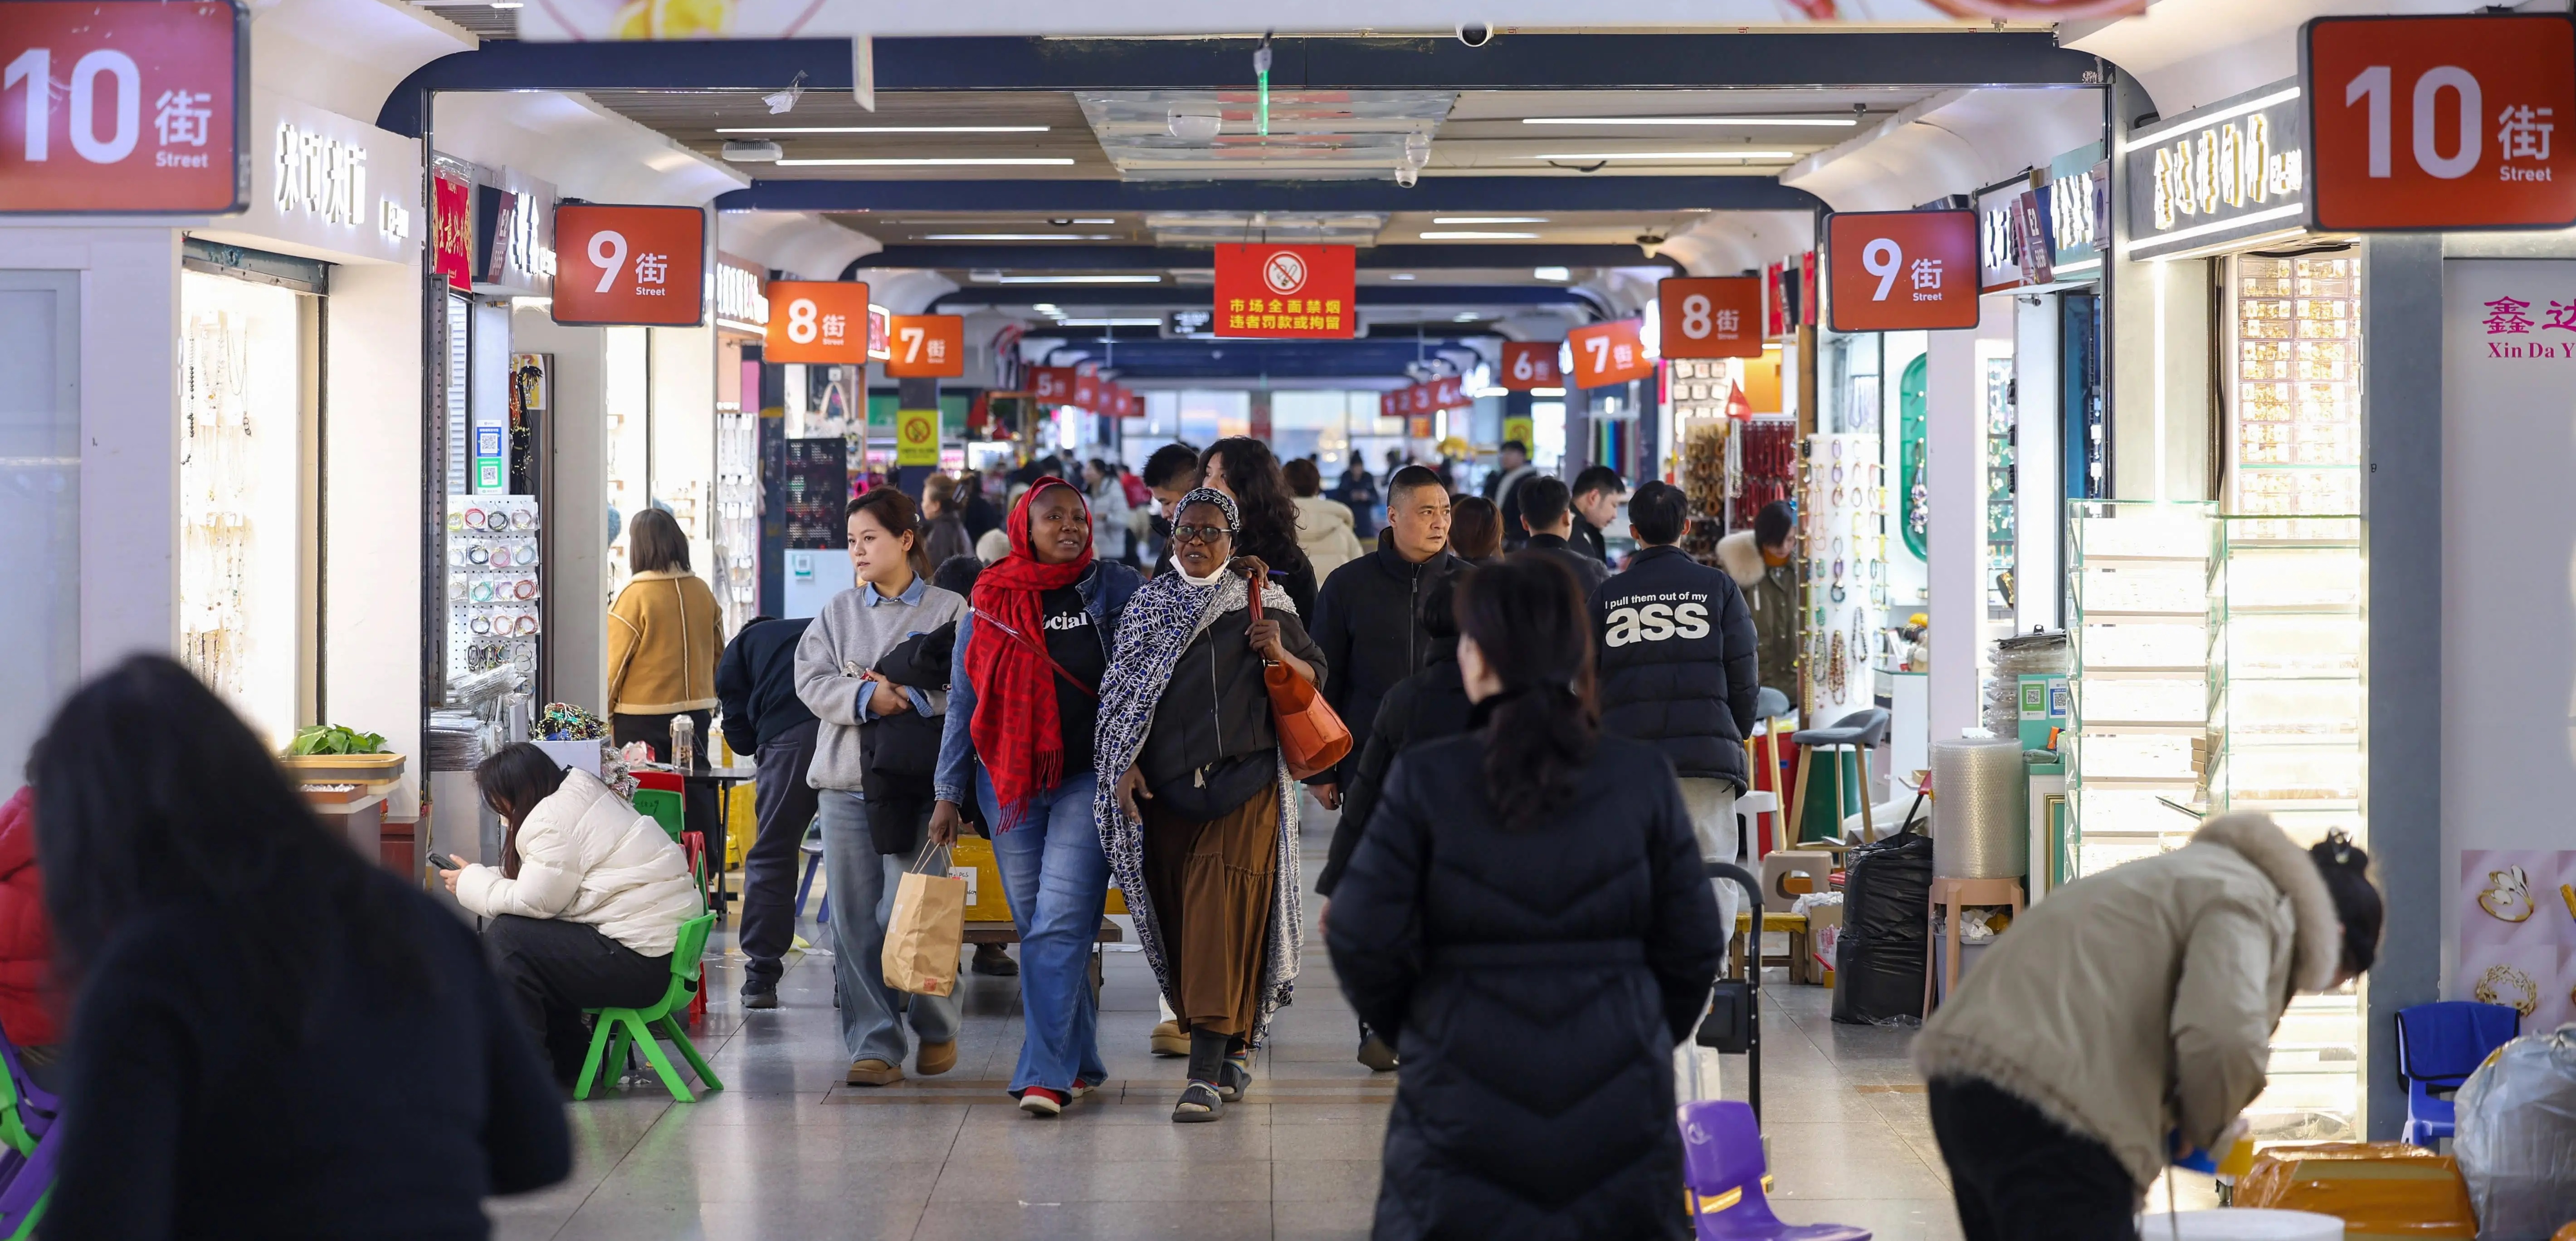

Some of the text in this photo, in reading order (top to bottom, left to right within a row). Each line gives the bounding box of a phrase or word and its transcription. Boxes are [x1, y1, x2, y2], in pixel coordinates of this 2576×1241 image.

[4, 48, 212, 164] 10 街
[2346, 66, 2482, 179] 10
[2498, 104, 2554, 161] 街
[156, 151, 208, 168] Street
[2500, 166, 2552, 182] Street
[499, 209, 509, 237] E2
[2027, 208, 2039, 236] E2
[588, 230, 628, 293] 9
[635, 253, 667, 284] 街
[1863, 238, 1942, 301] 9 街
[636, 287, 665, 296] Street
[1912, 293, 1942, 301] Street
[1229, 298, 1341, 314] 市场全面禁烟
[1682, 294, 1739, 339] 8 街
[2482, 296, 2576, 335] 鑫达
[787, 298, 817, 344] 8
[822, 314, 845, 337] 街
[1229, 315, 1341, 330] 违者罚款或拘留
[900, 327, 924, 364] 7
[1586, 336, 1610, 373] 7
[2488, 342, 2522, 358] Xin
[2528, 342, 2554, 358] Da
[1513, 350, 1533, 381] 6
[1037, 372, 1052, 396] 5
[1437, 383, 1452, 404] 4
[1610, 596, 1628, 610] pull
[1631, 593, 1656, 604] them
[1659, 592, 1677, 601] out
[1678, 592, 1690, 600] of
[1692, 594, 1708, 602] my
[1605, 602, 1710, 648] ass
